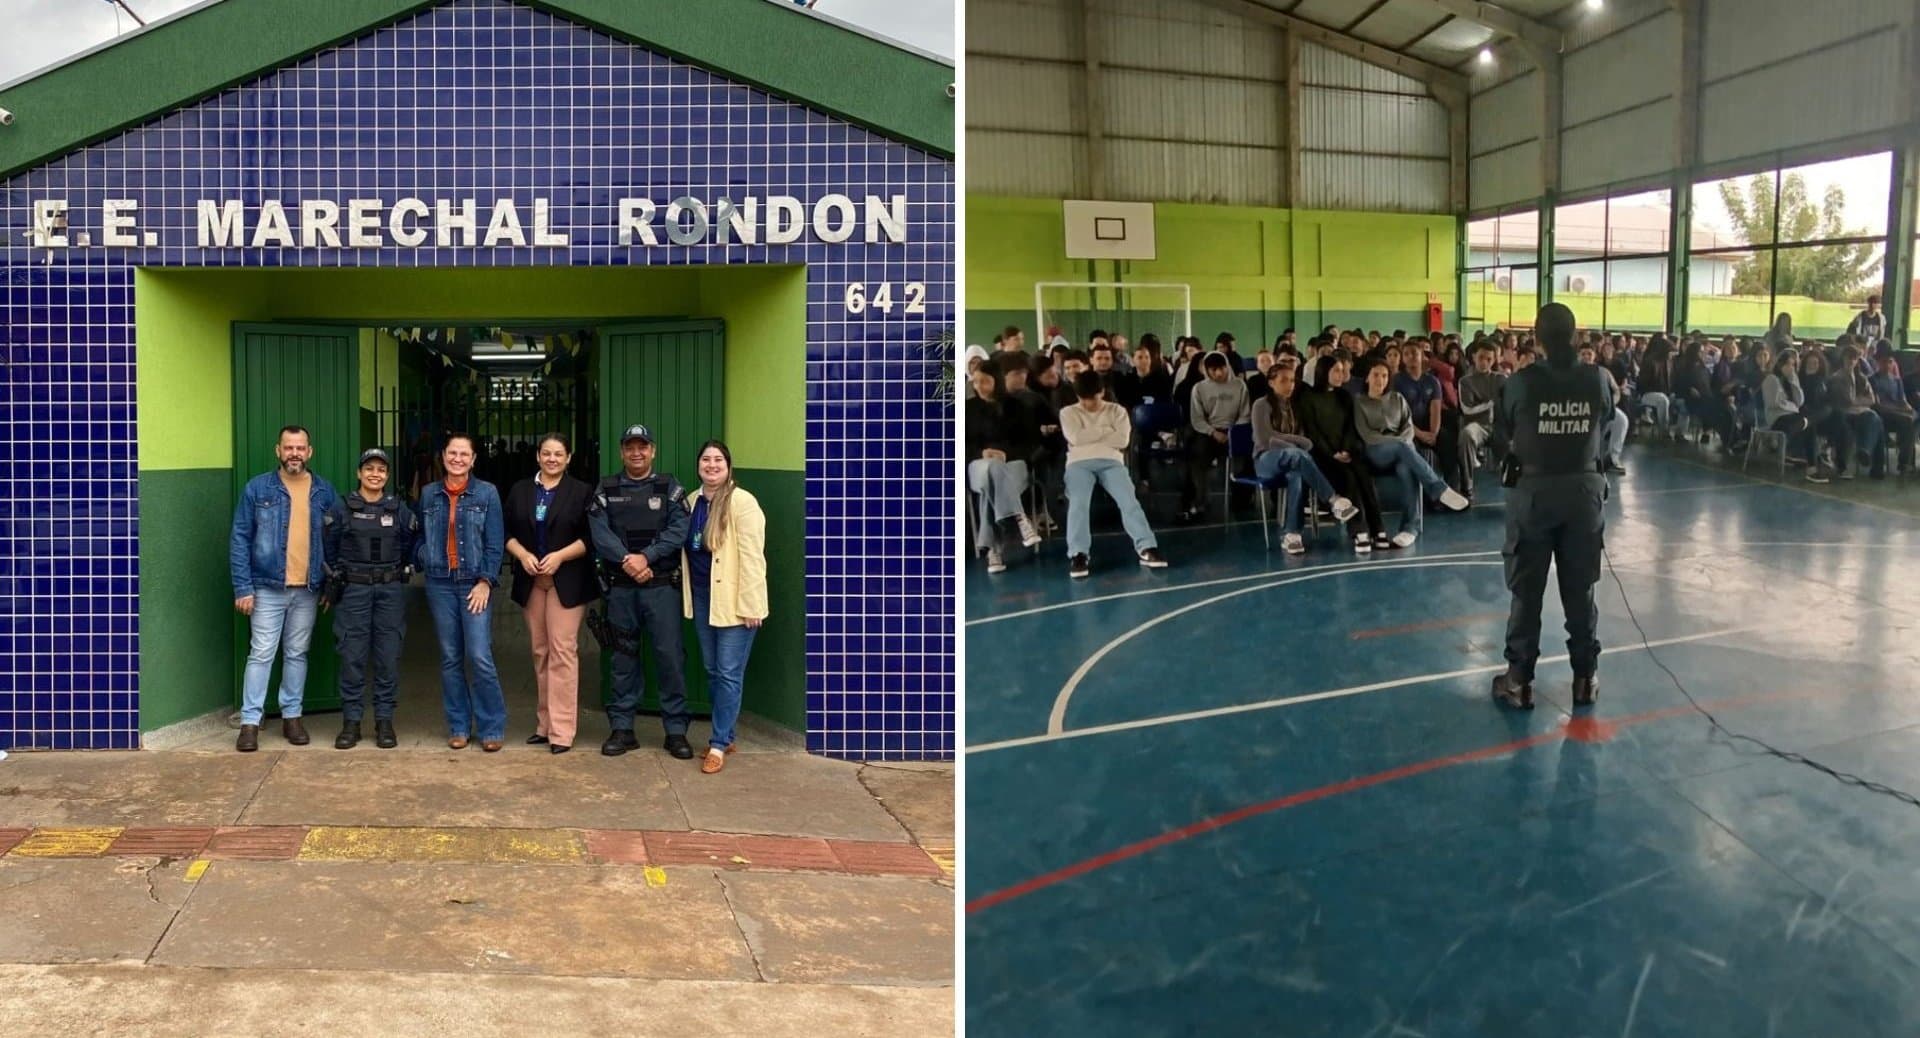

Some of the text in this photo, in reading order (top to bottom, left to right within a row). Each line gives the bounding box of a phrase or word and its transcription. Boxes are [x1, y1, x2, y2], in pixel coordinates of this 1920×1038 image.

[197, 198, 570, 247] MARECHAL
[618, 194, 906, 246] RONDON
[846, 282, 926, 313] 642
[1539, 401, 1591, 417] POLÍCIA
[1538, 420, 1590, 434] MILITAR
